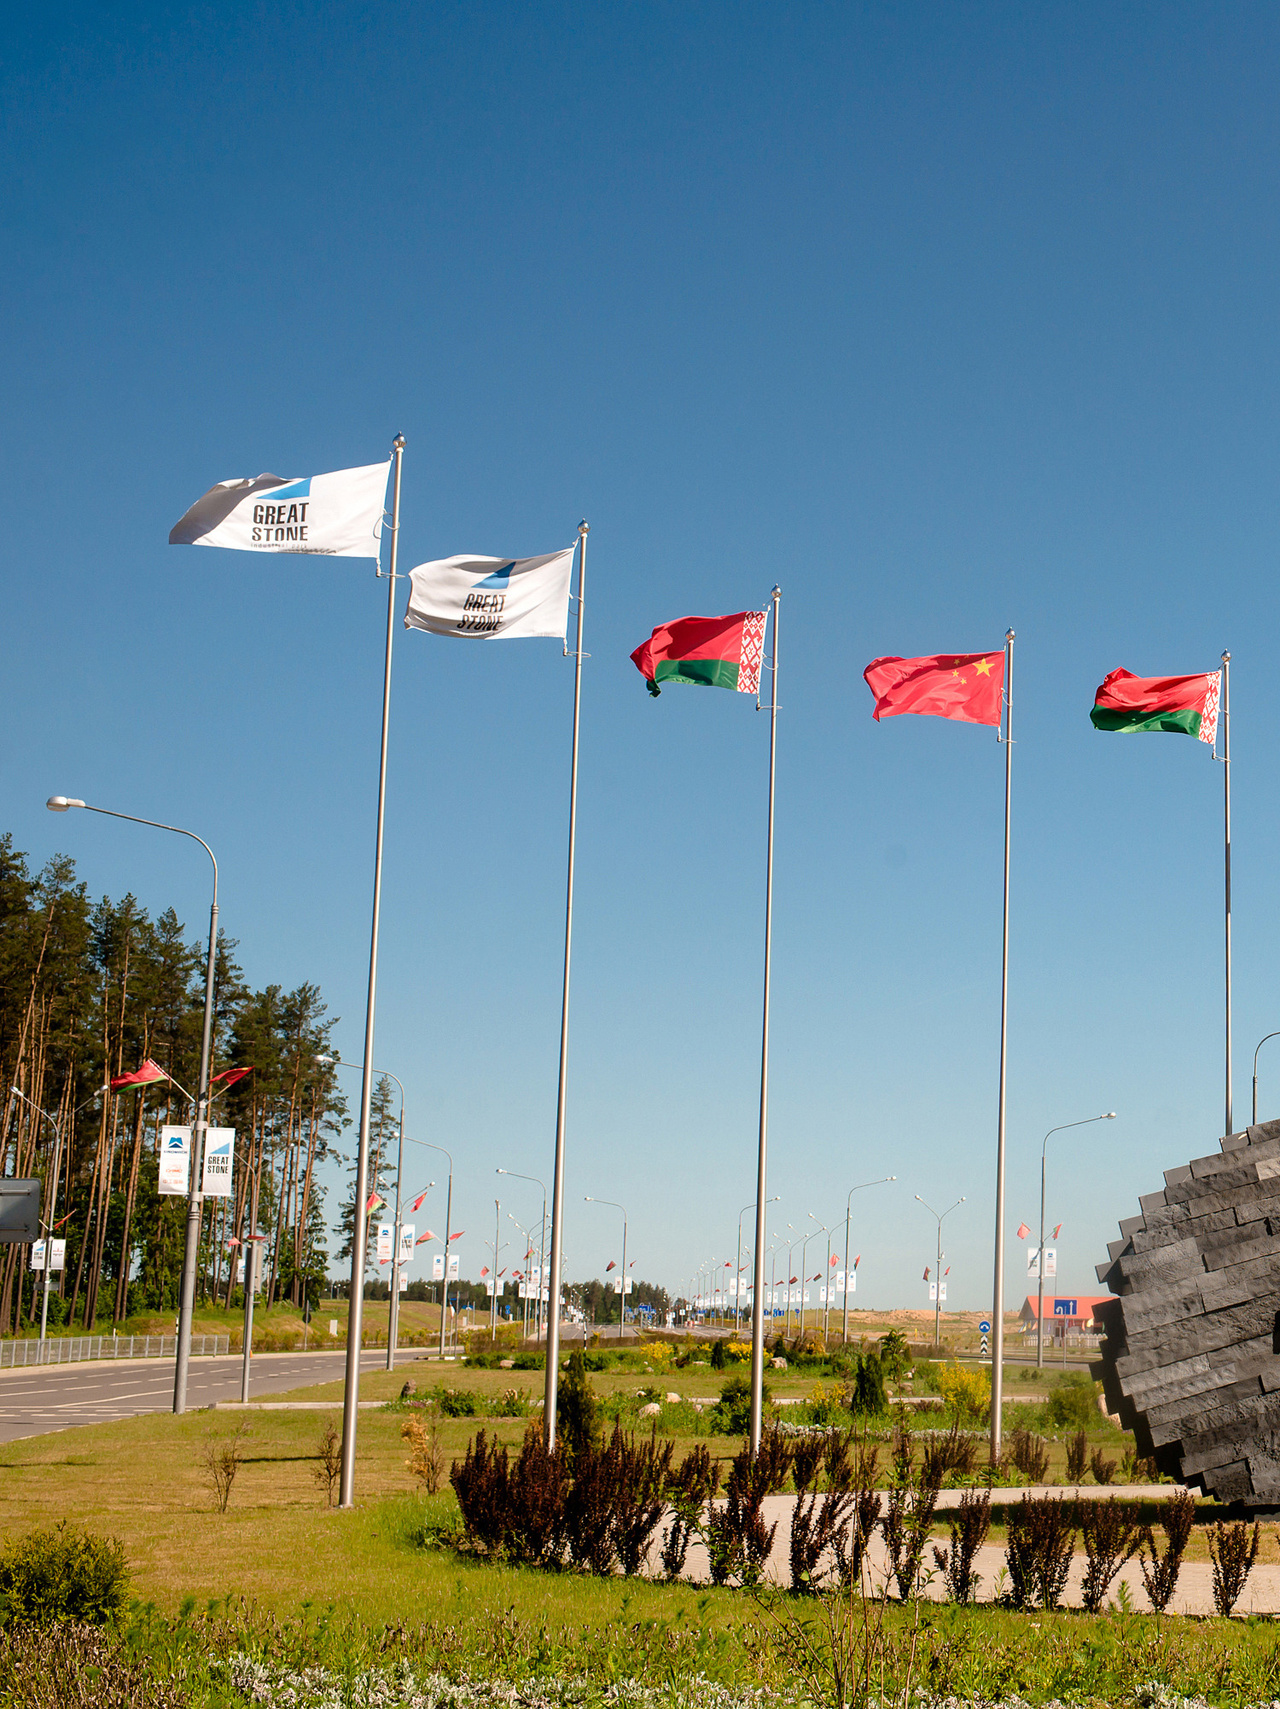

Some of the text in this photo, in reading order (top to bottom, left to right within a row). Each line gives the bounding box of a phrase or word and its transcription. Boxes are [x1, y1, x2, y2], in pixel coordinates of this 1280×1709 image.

[252, 502, 310, 525] GREAT
[251, 525, 309, 542] STONE
[463, 593, 507, 613] GREAT
[456, 614, 504, 631] STONE
[207, 1156, 229, 1165] GREAT
[207, 1165, 229, 1174] STONE
